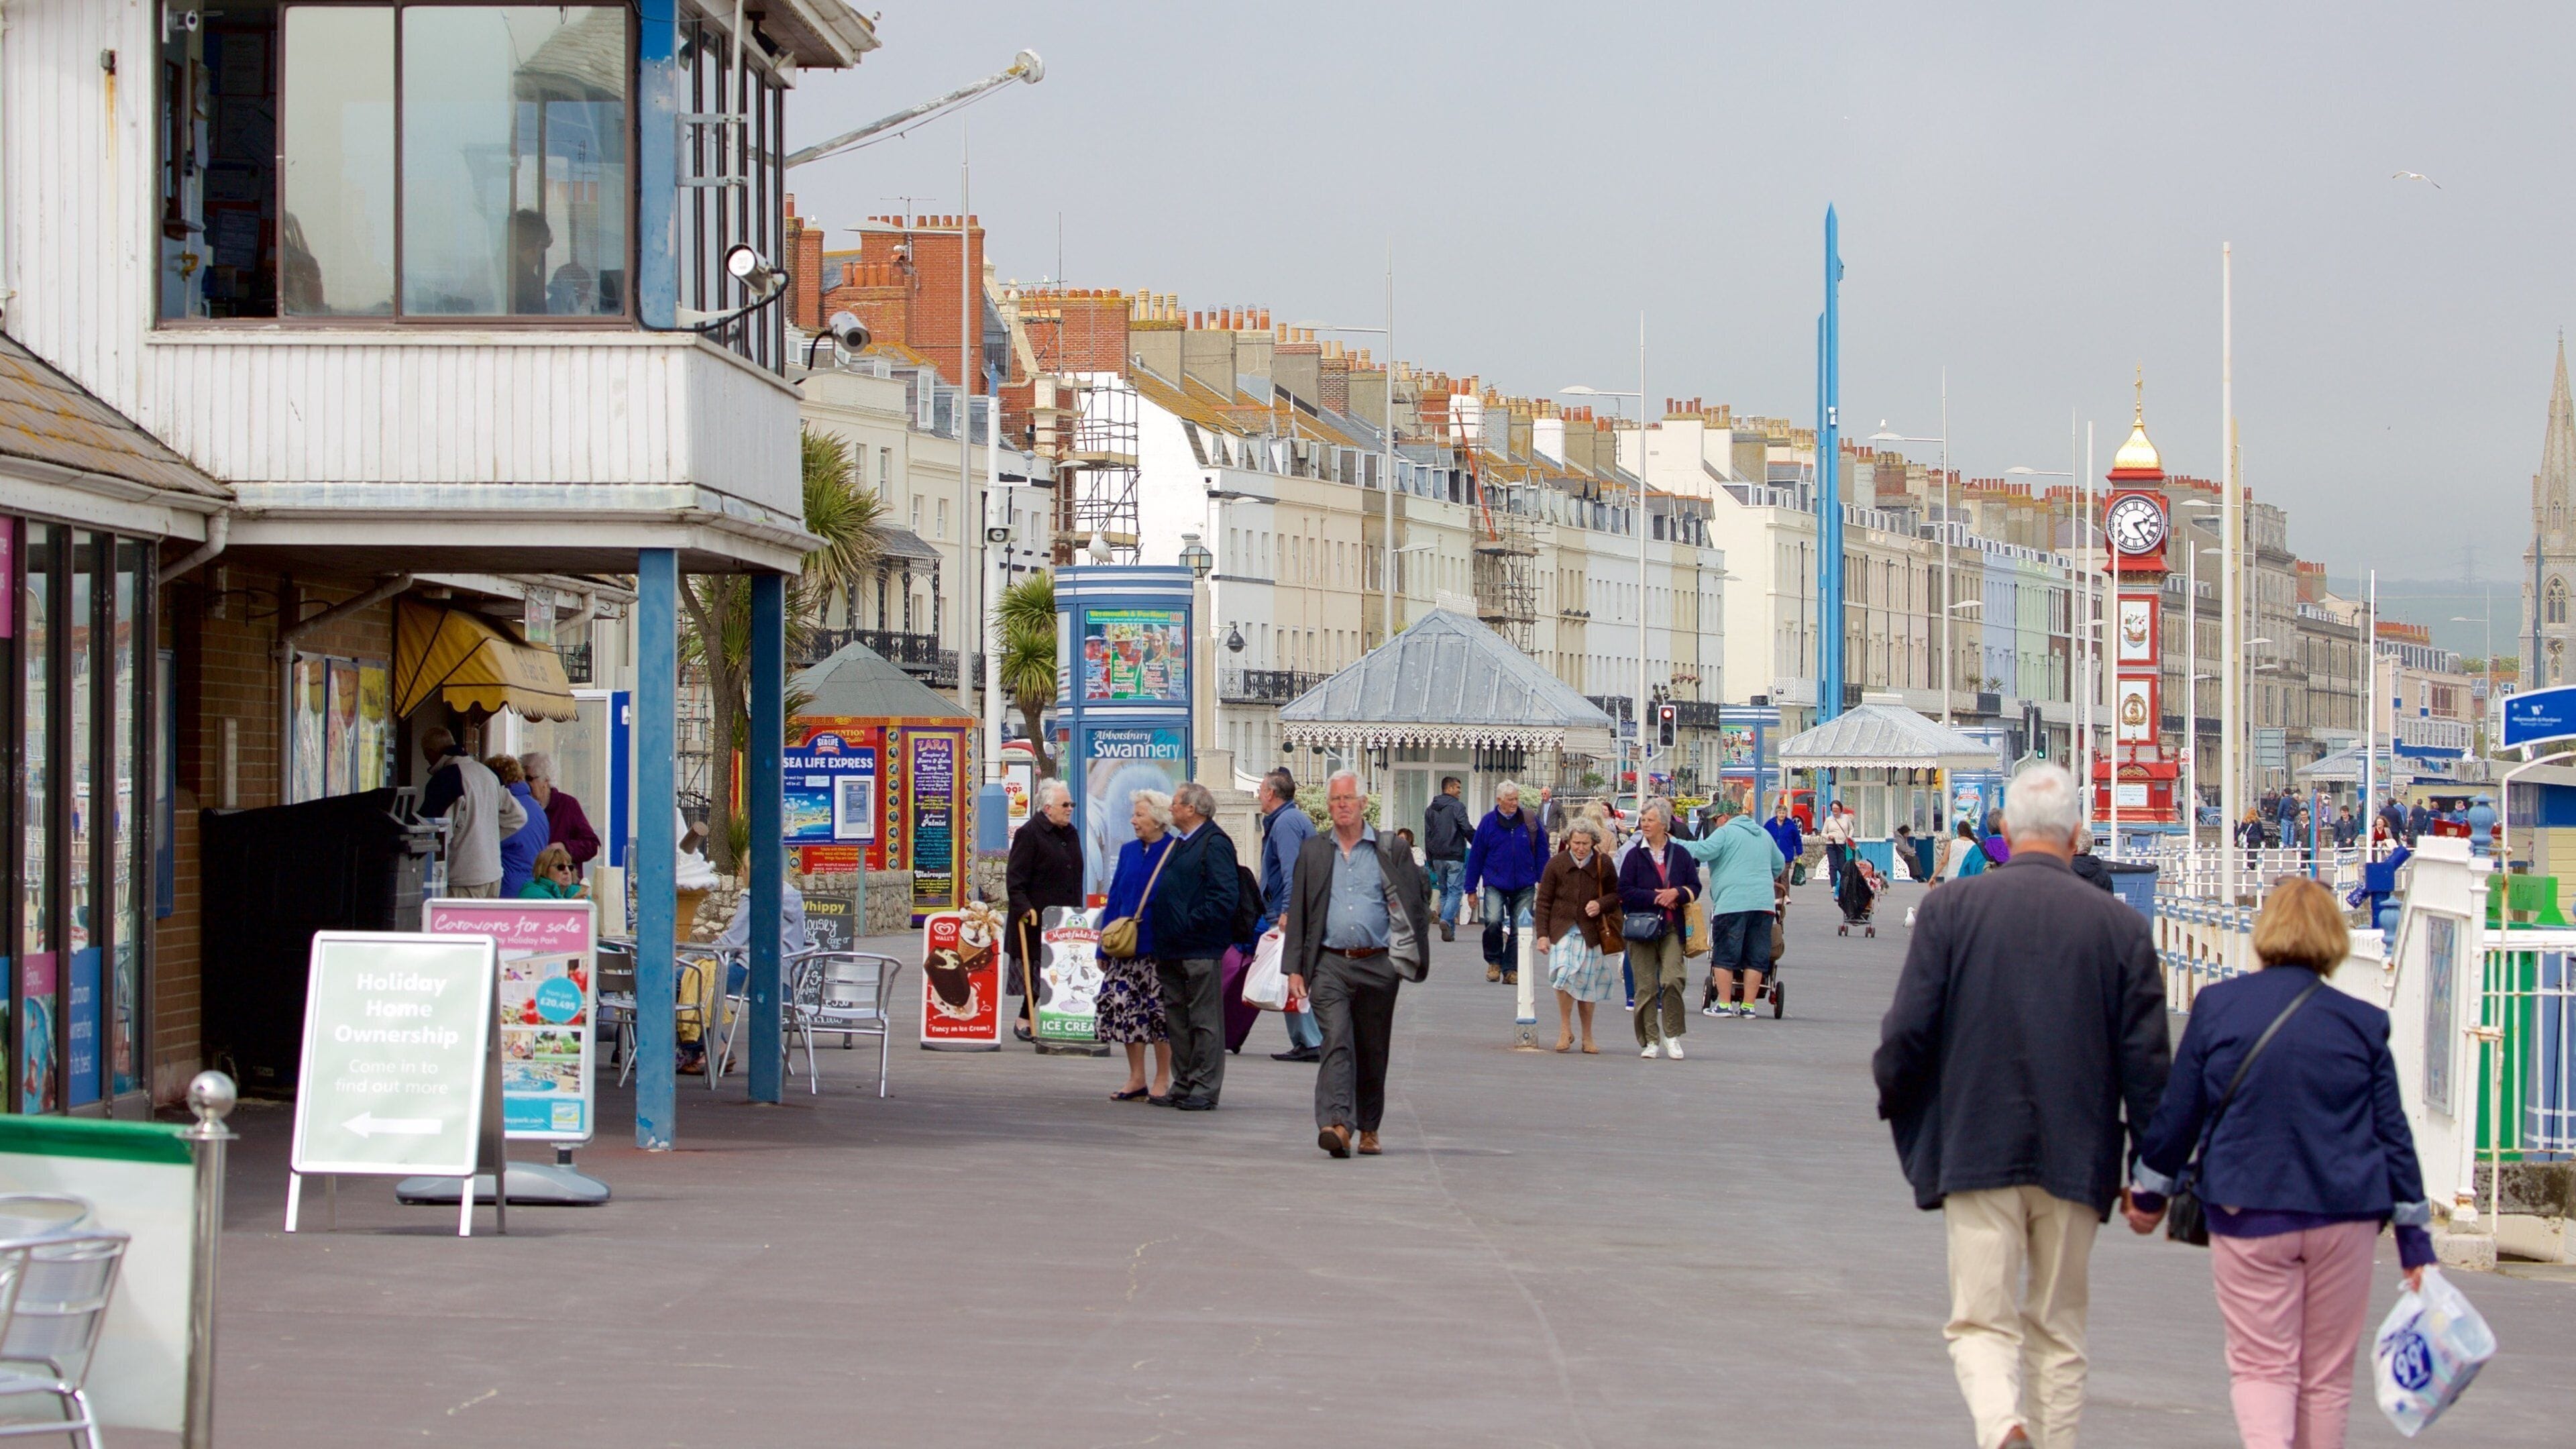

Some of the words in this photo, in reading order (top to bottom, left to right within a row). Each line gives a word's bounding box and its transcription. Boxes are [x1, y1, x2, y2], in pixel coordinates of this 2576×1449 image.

[1093, 729, 1151, 745] Abbotsbury
[917, 739, 949, 752] ZARA
[1094, 741, 1180, 763] Swannery
[784, 757, 802, 768] SEA
[804, 757, 826, 768] LIFE
[828, 757, 874, 769] EXPRESS
[921, 819, 947, 827] Palmist
[914, 870, 951, 879] Clairvoyant
[435, 914, 510, 931] Caravans
[515, 916, 540, 937] for
[546, 916, 581, 933] sale
[508, 936, 538, 946] Holiday
[540, 936, 558, 945] Park
[357, 972, 447, 998] Holiday
[366, 999, 433, 1018] Home
[1042, 1020, 1061, 1030] ICE
[1065, 1021, 1095, 1032] CREA
[335, 1024, 459, 1050] Ownership
[349, 1059, 396, 1073] Come
[401, 1059, 415, 1073] in
[422, 1061, 438, 1074] to
[335, 1078, 368, 1093] find
[372, 1080, 400, 1093] out
[405, 1082, 449, 1094] more
